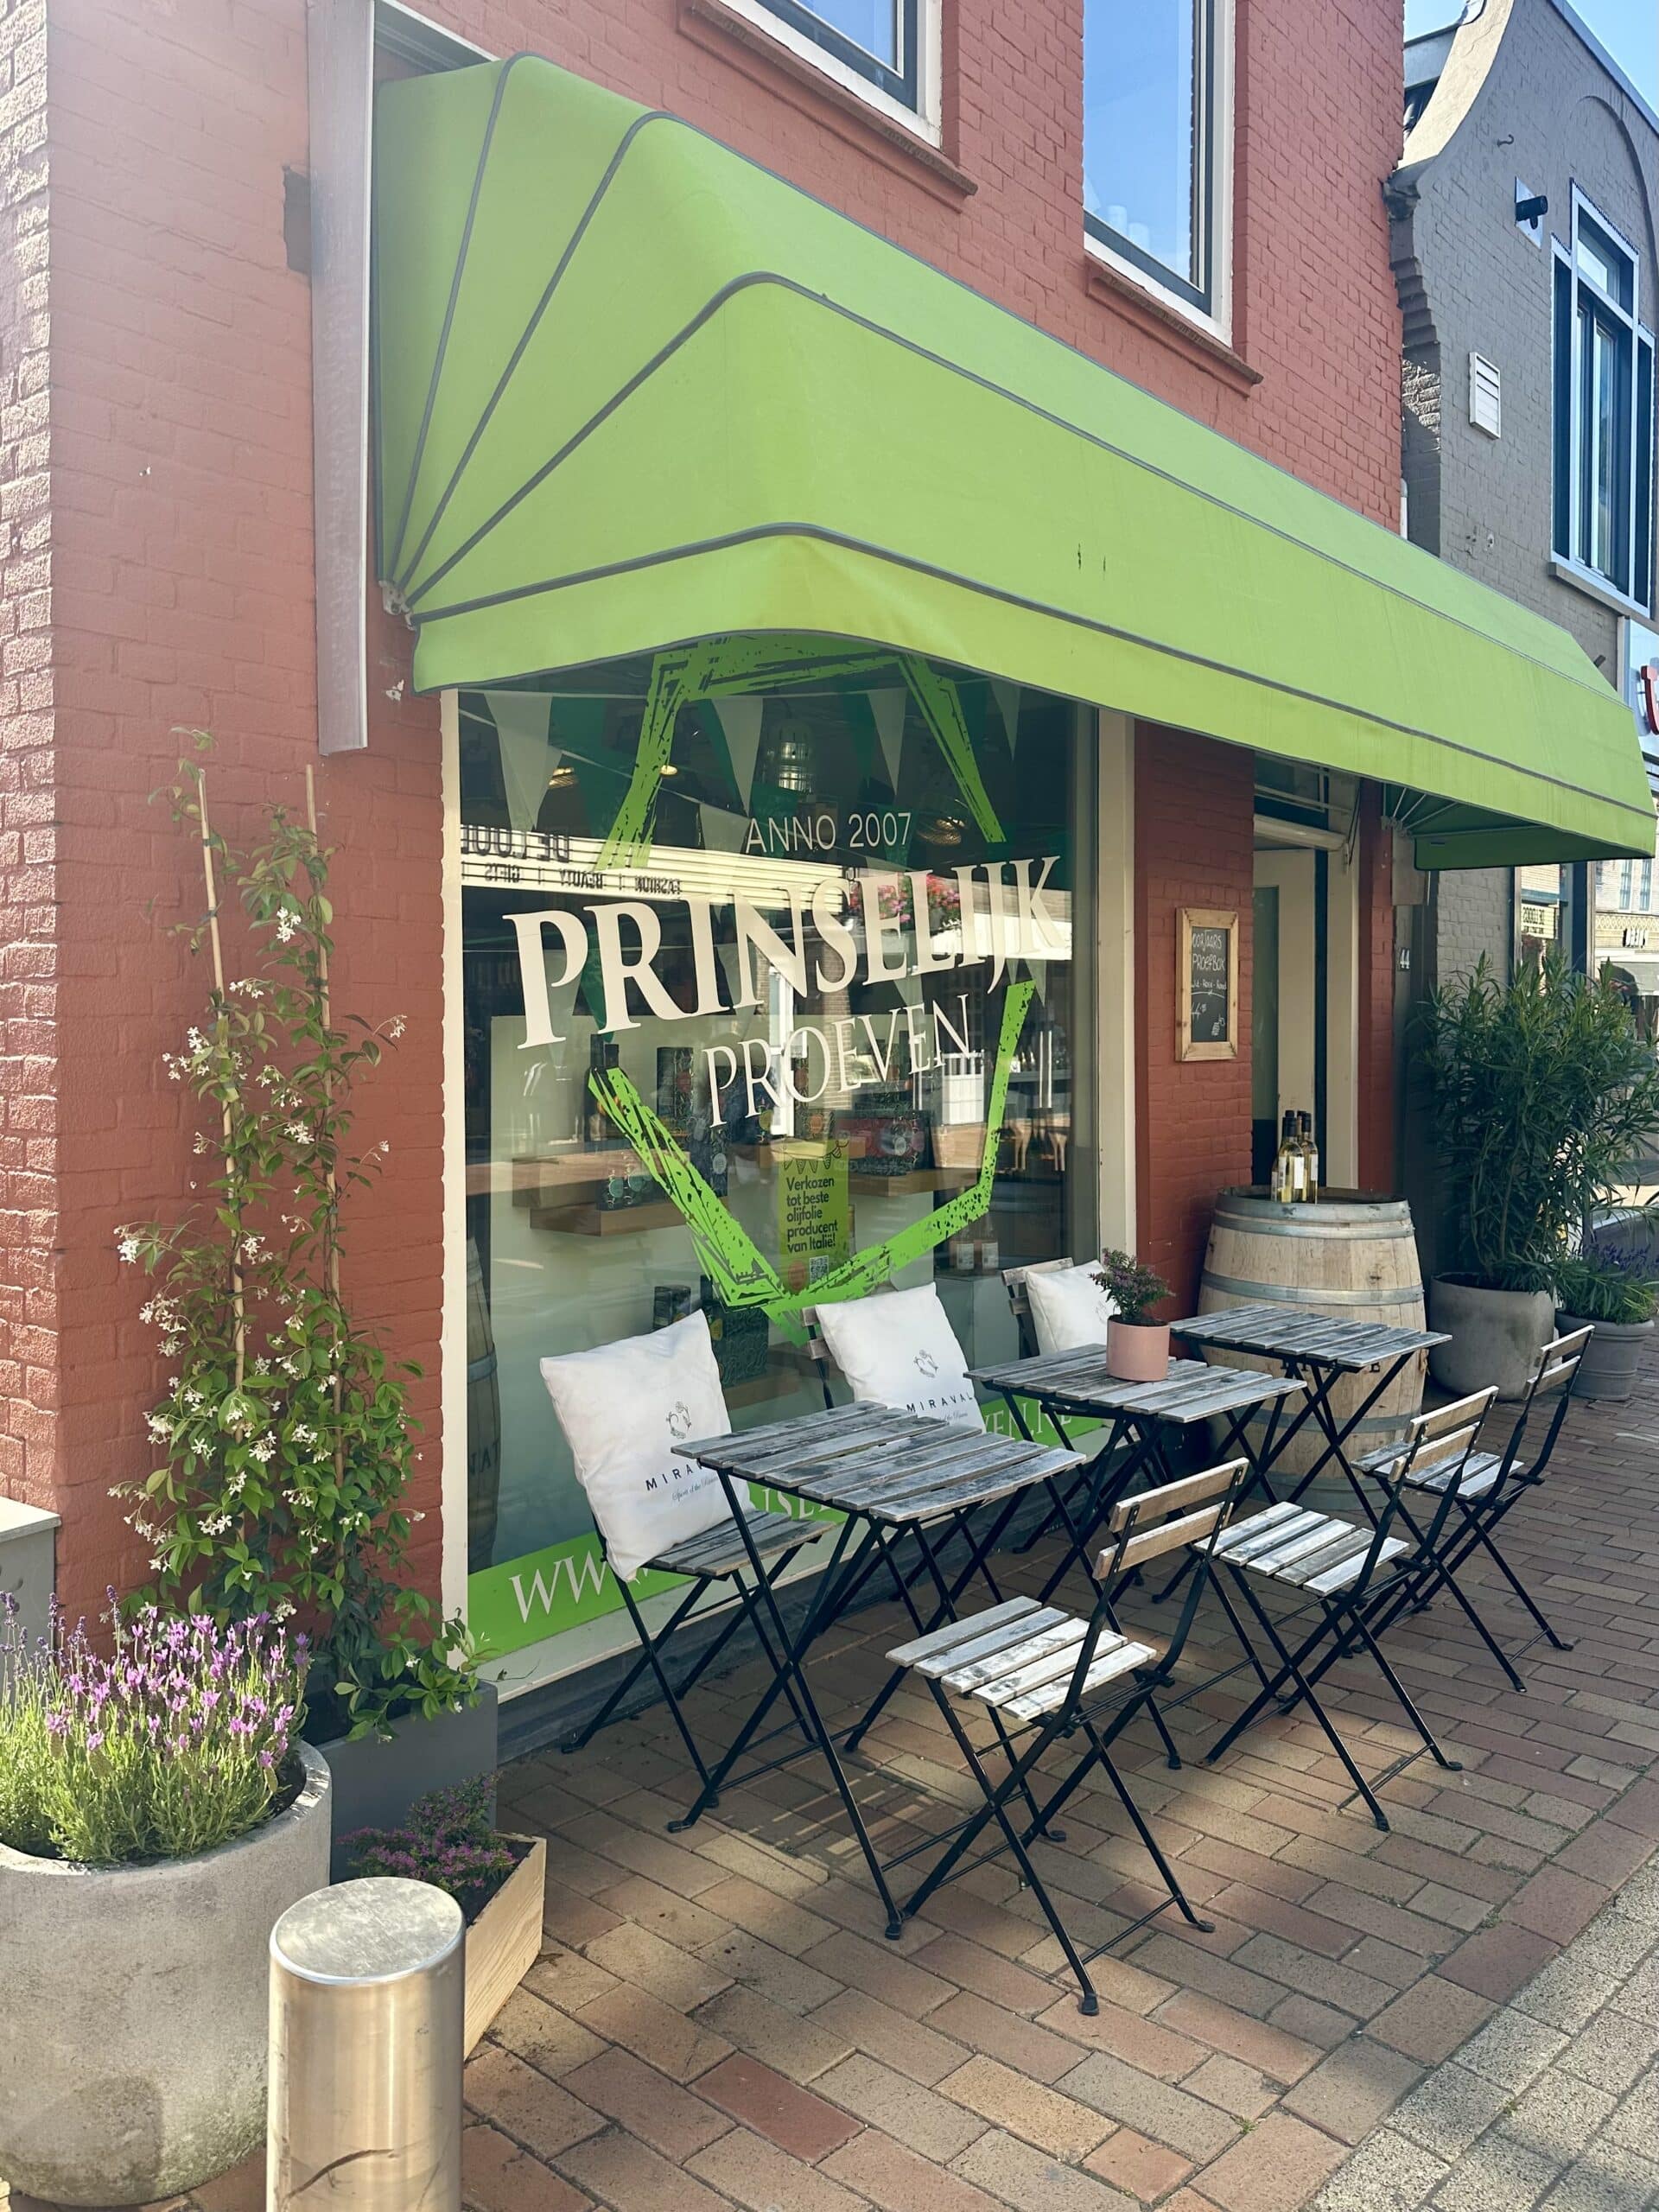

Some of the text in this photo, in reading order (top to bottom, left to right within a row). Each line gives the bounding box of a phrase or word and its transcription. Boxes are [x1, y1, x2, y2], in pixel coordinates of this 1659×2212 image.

[746, 812, 912, 854] ANNO 2007
[503, 855, 1065, 1050] PRINSELIJK
[702, 994, 976, 1129] PROEVEN
[786, 1175, 835, 1191] Verkozen
[786, 1191, 830, 1207] tot beste
[786, 1207, 823, 1225] olijfolie
[787, 1219, 838, 1243] producent
[787, 1233, 836, 1254] van Italië!
[906, 1391, 974, 1414] MIRAVAL
[645, 1460, 702, 1491] MIRA
